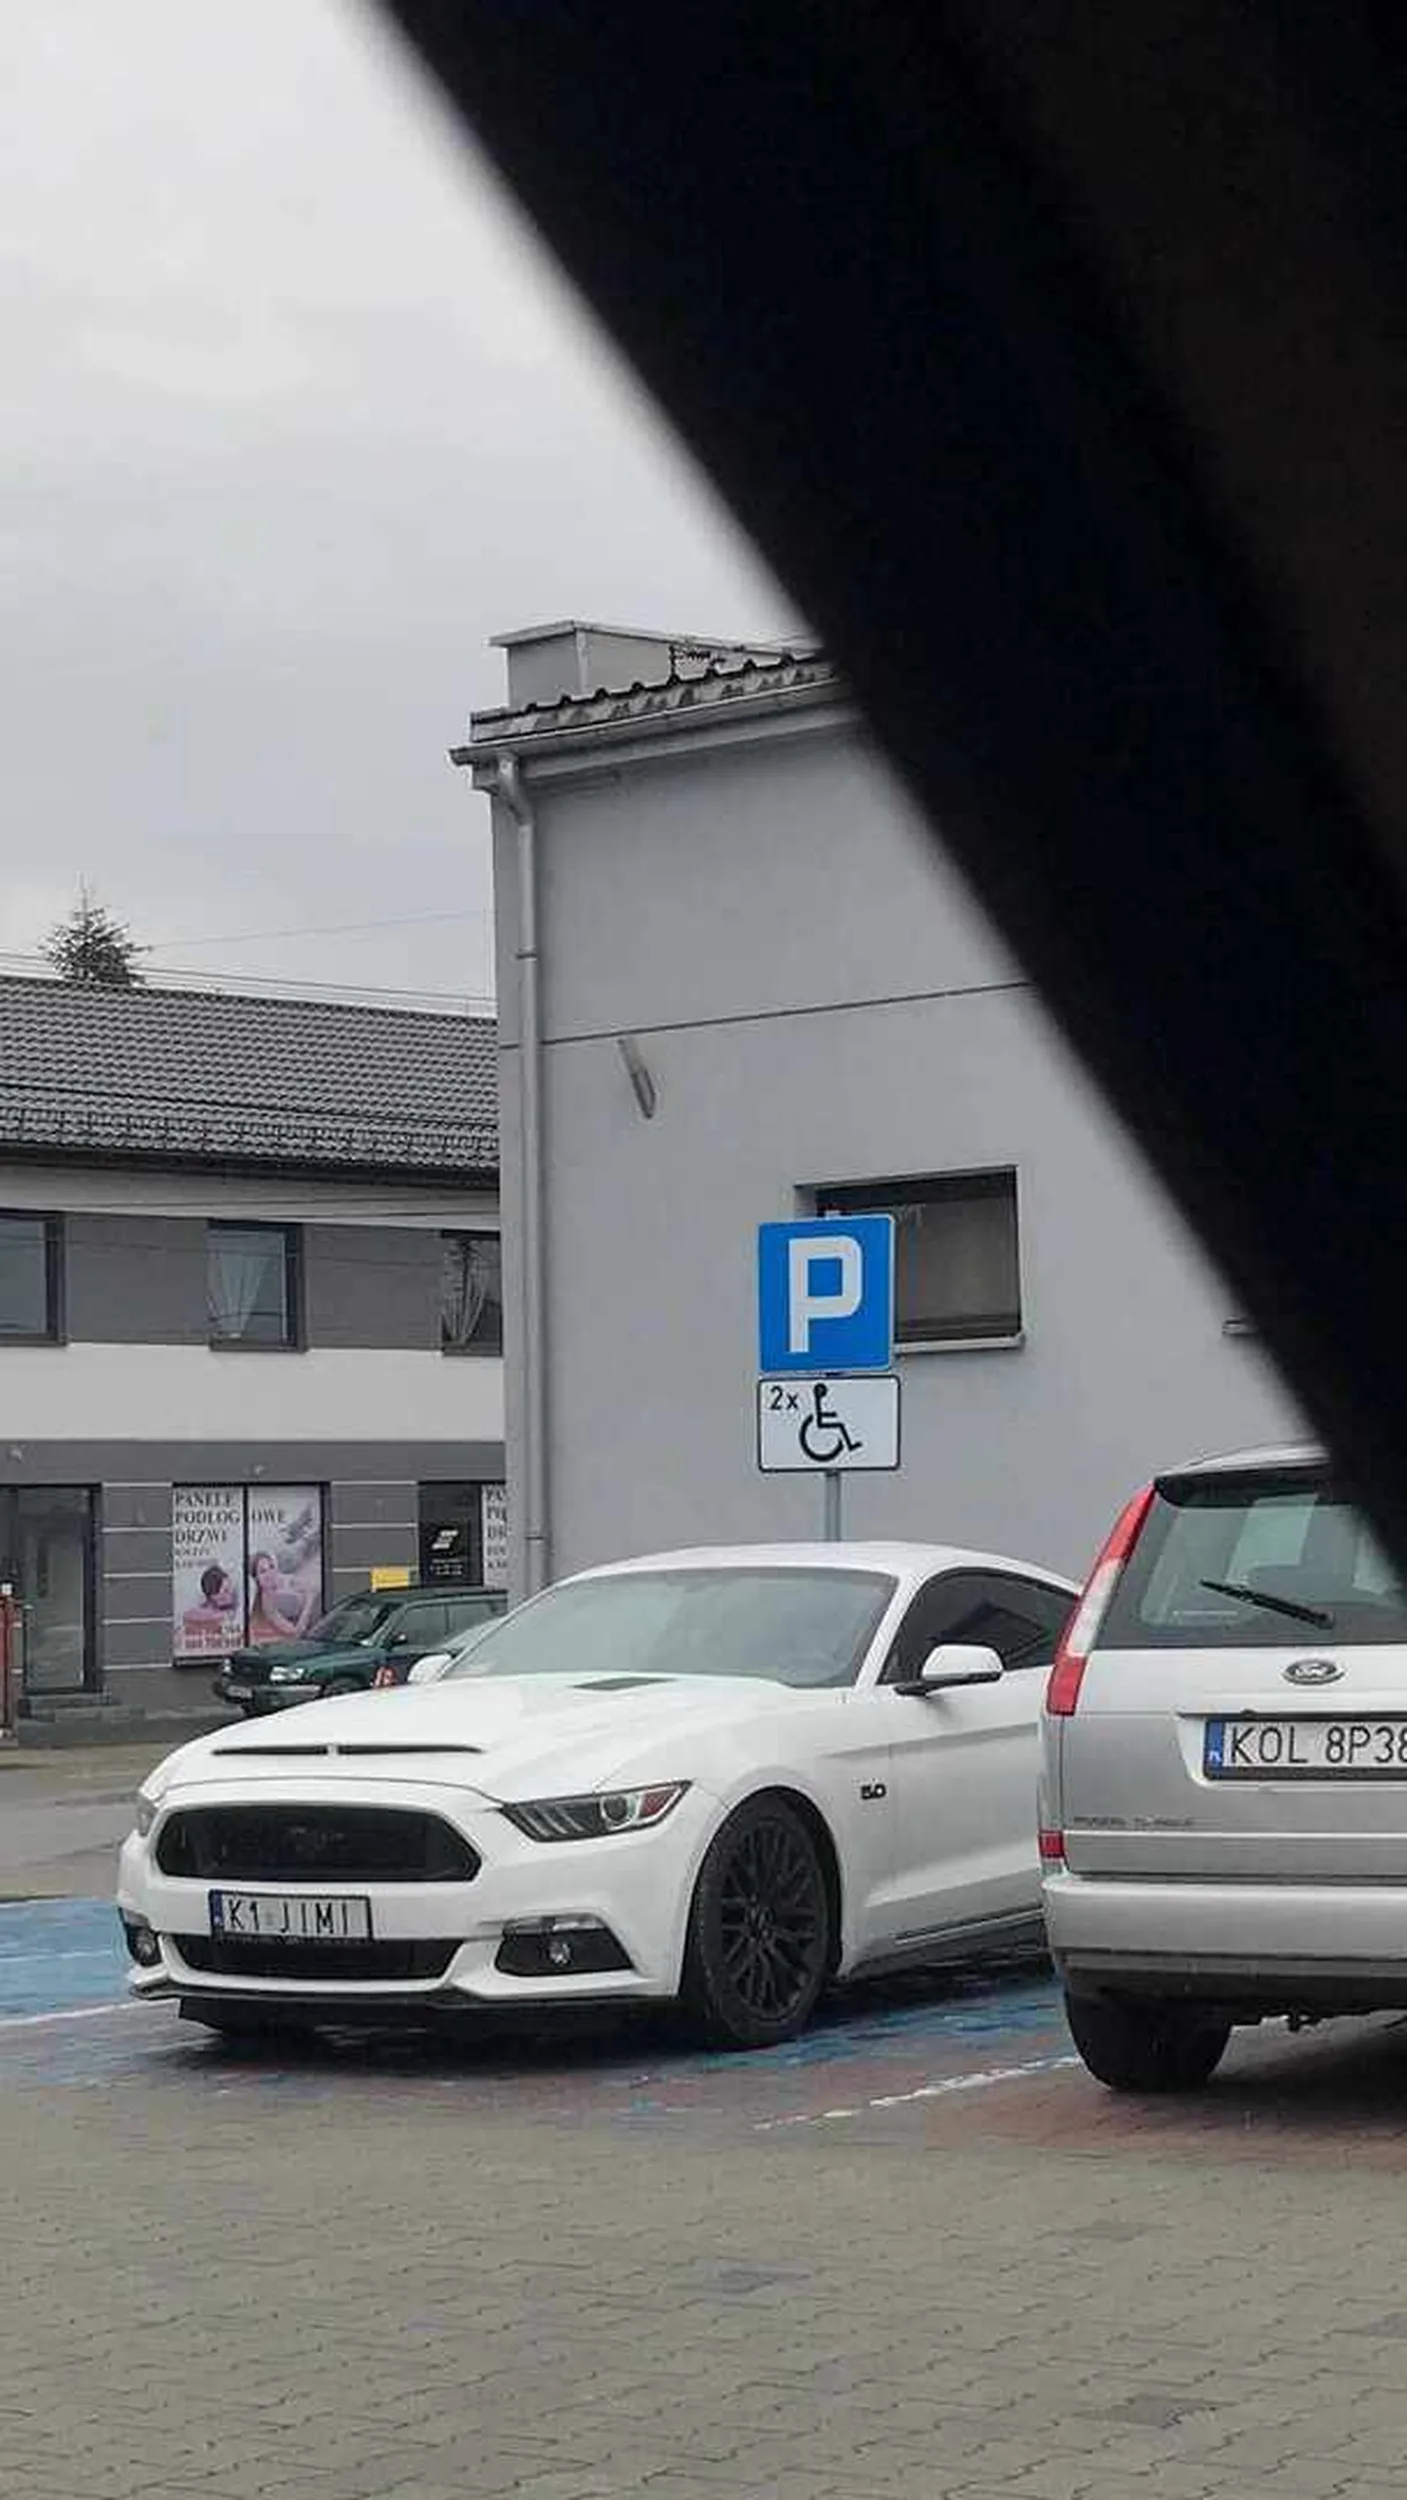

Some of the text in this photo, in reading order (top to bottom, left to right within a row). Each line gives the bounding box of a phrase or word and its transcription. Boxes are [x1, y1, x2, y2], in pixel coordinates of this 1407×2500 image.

[788, 1235, 862, 1353] P
[769, 1386, 799, 1410] 2x
[1231, 1726, 1308, 1764] KOL
[228, 1899, 348, 1935] K1 JIMI
